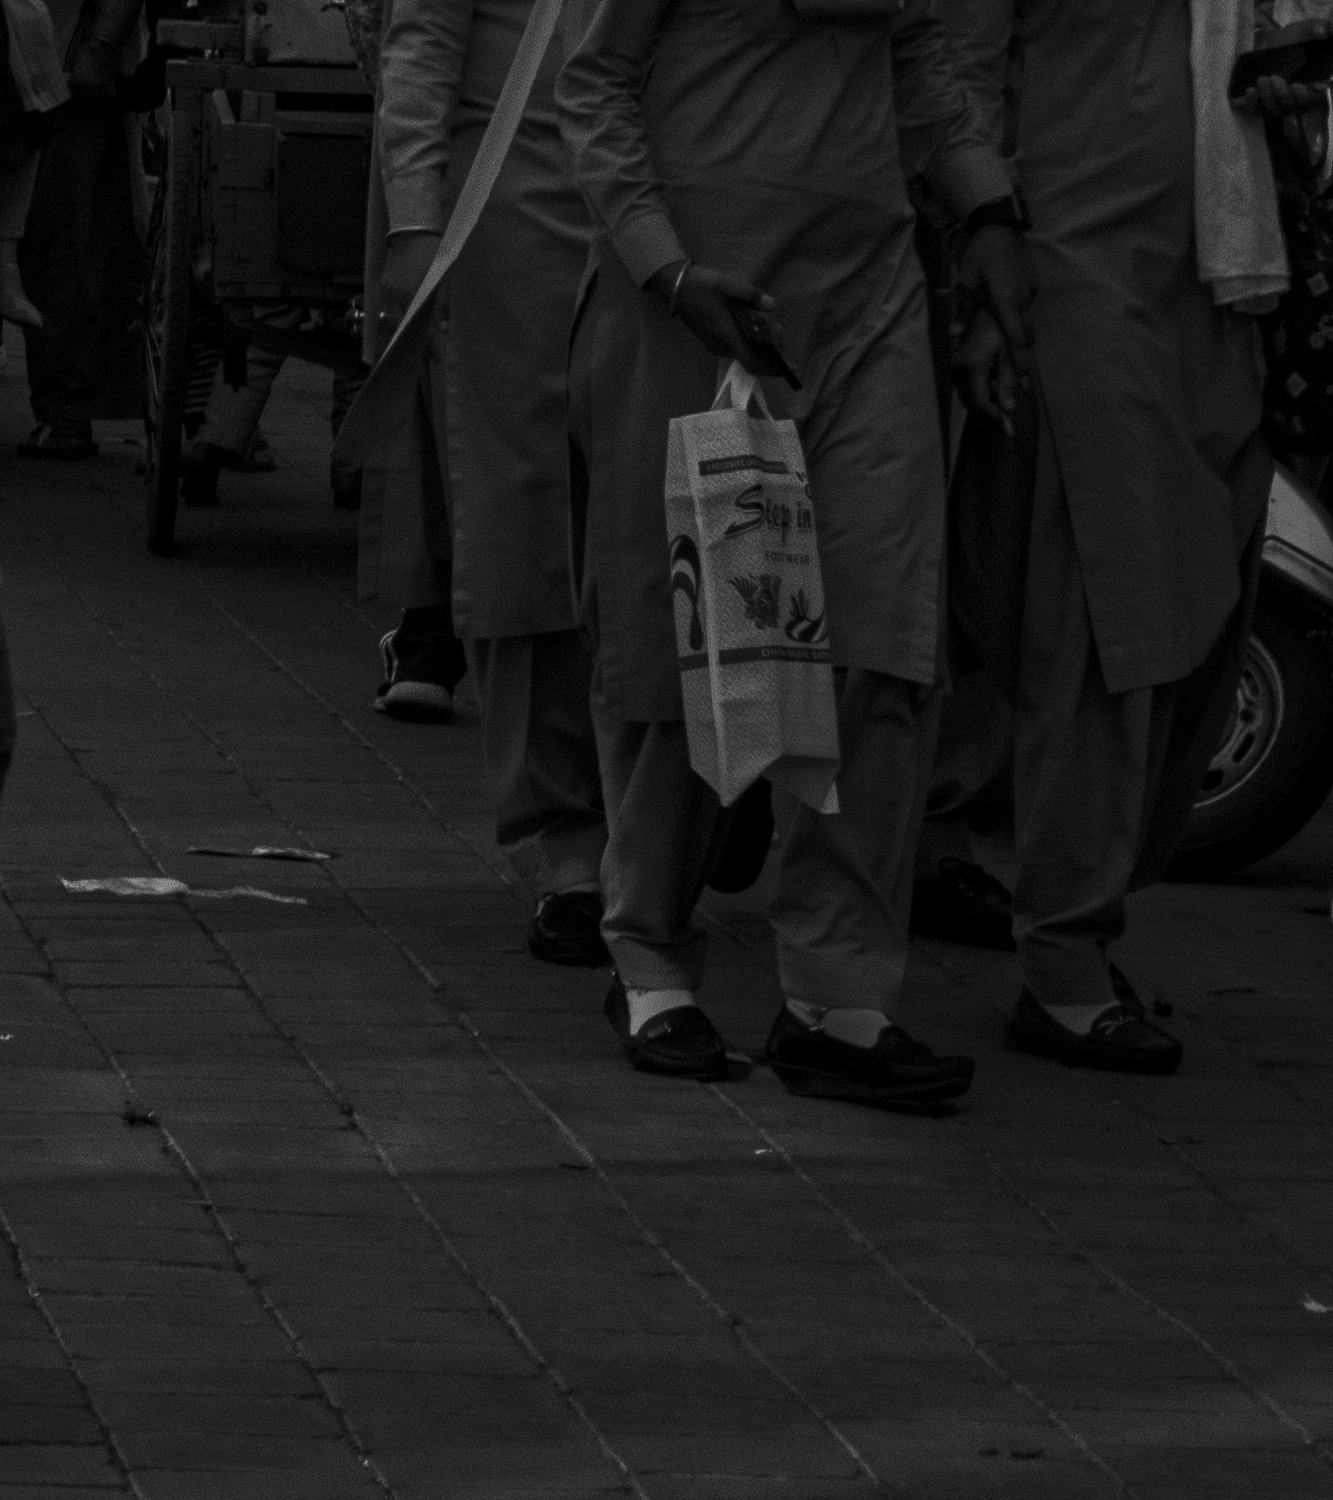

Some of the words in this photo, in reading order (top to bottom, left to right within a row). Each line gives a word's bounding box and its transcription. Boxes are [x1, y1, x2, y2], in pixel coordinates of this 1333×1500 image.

[723, 483, 791, 548] Step
[796, 500, 812, 530] in
[764, 550, 811, 566] FOOTWEAR
